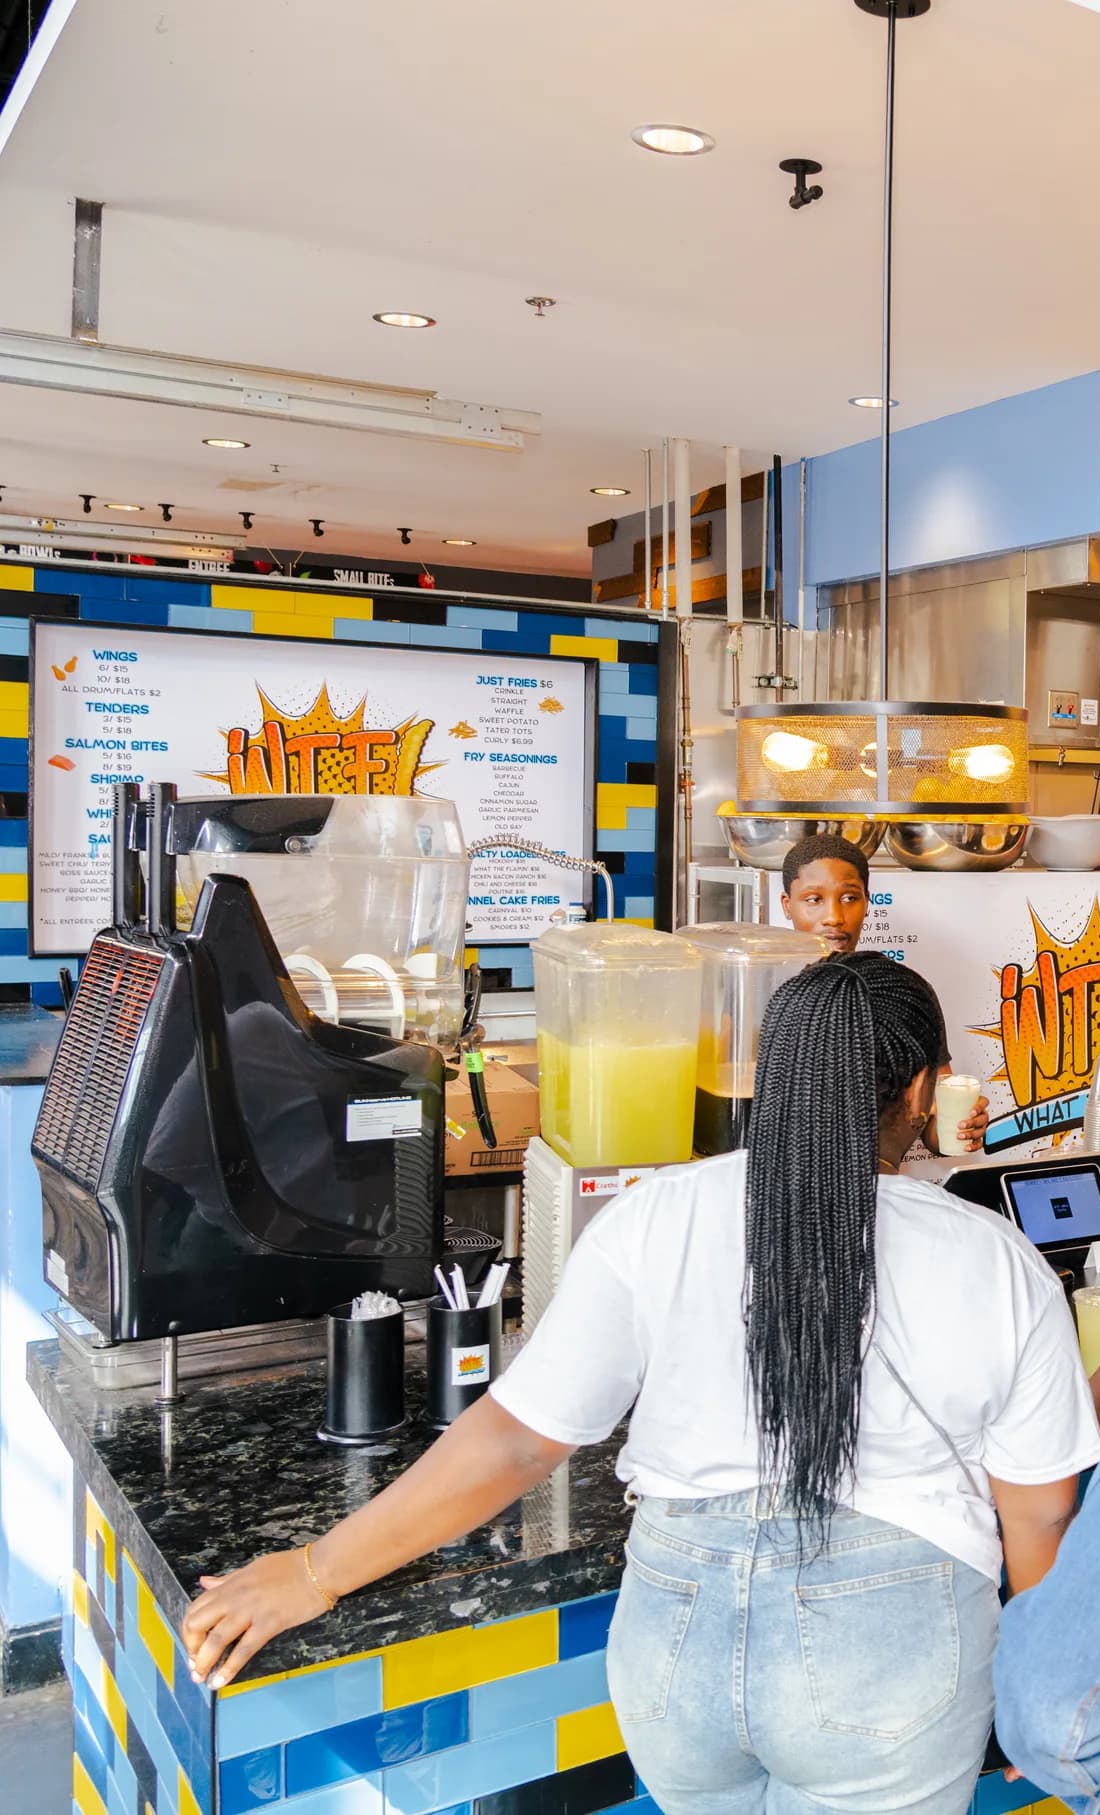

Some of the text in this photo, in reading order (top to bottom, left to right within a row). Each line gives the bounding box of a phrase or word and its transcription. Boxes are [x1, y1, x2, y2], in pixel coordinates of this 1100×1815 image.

[333, 570, 364, 585] SMALL
[92, 649, 138, 662] WINGS
[113, 665, 128, 673] $15
[115, 676, 130, 684] $18
[476, 675, 553, 688] JUST FRIES $6
[61, 685, 161, 697] ALL DRUM/FLATS $2
[491, 697, 527, 705] STRAIGHT
[85, 701, 149, 714] TENDERS
[117, 716, 132, 724] $15
[116, 727, 132, 735] $18
[65, 738, 169, 752] SALMON BITES
[464, 752, 558, 764] FRY SEASONINGS
[91, 773, 144, 784] SHRIMP
[467, 896, 560, 905] NNEL CAKE FRIES
[873, 909, 888, 917] $15
[860, 935, 918, 944] UM/FLATS $2
[1014, 1096, 1079, 1134] WHAT
